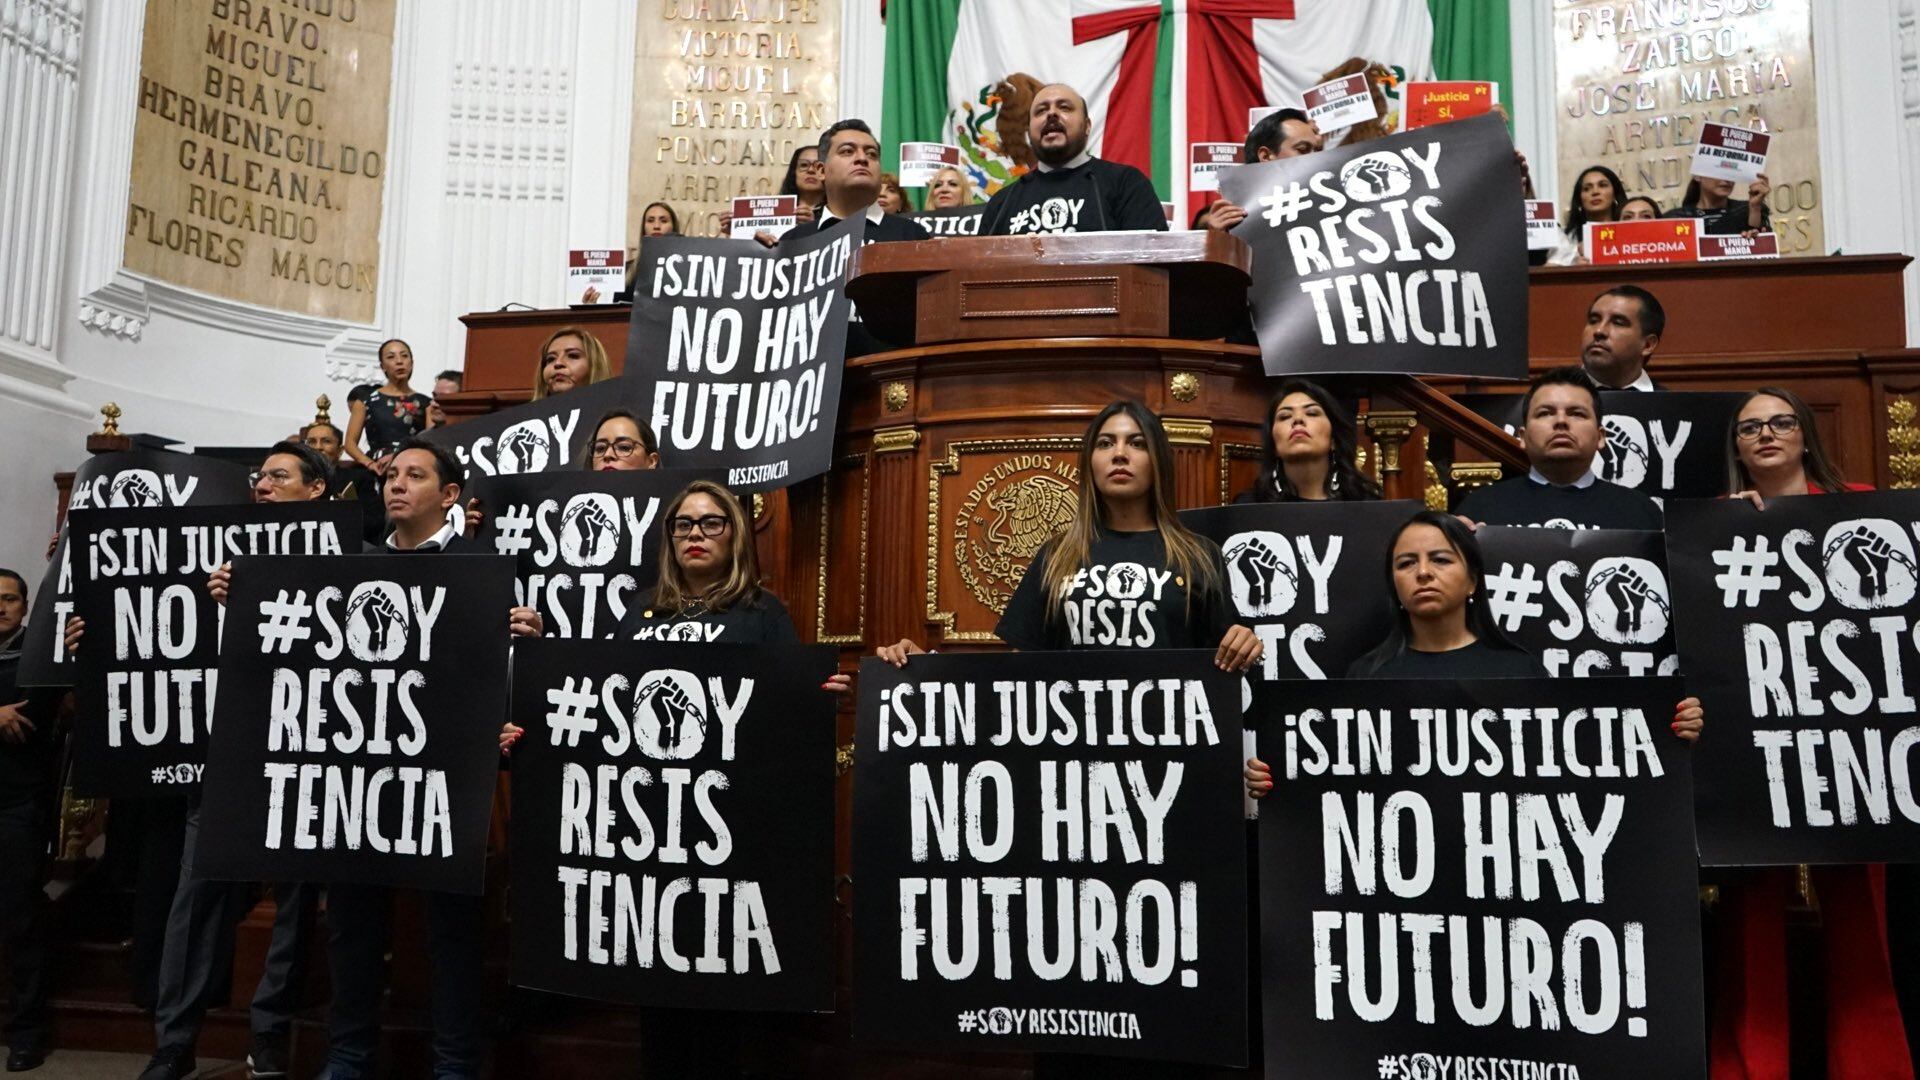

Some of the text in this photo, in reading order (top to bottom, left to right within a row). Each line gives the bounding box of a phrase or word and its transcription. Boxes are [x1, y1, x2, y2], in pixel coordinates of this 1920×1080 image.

[204, 65, 323, 130] BRAVO.
[205, 24, 326, 92] MIGUEL
[686, 65, 798, 95] MIGUEL
[1567, 57, 1792, 118] JOSE MARIA
[139, 76, 381, 178] HERMENEGILDO
[1713, 148, 1749, 162] REFORMA
[178, 140, 342, 211] GALEANA.
[188, 183, 318, 244] RICARDO
[128, 203, 245, 268] FLORES
[747, 218, 778, 226] REFORMA
[1286, 195, 1456, 276] RESIS
[1603, 241, 1686, 256] LA REFORMA
[653, 234, 850, 300] ¡SIN JUSTICIA
[667, 289, 834, 374] NO HAY
[1300, 269, 1497, 349] TENCIA
[651, 362, 827, 450] FUTURO!
[728, 460, 788, 486] RESISTENCIA
[955, 472, 996, 539] ESTADOS
[994, 454, 1052, 480] UNIDOS
[89, 526, 167, 581] ¡SIN
[1712, 518, 1920, 612] #SO
[114, 584, 197, 661] NO
[1064, 599, 1157, 648] RESIS
[1484, 556, 1670, 644] #SO
[1743, 615, 1920, 717] RESI
[268, 668, 427, 756] RESIS
[878, 678, 1220, 752] ¡SIN JUSTICIA
[1285, 707, 1392, 780] ¡SIN
[1408, 707, 1665, 778] JUSTICIA
[264, 763, 453, 858] TENCIA
[560, 762, 732, 866] RESIS
[909, 760, 1184, 864] NO HAY
[1752, 726, 1920, 828] TENC
[1322, 790, 1625, 904] NO HAY
[558, 866, 781, 975] TENCIA
[900, 877, 1198, 988] FUTURO!
[1312, 911, 1648, 1037] FUTURO!
